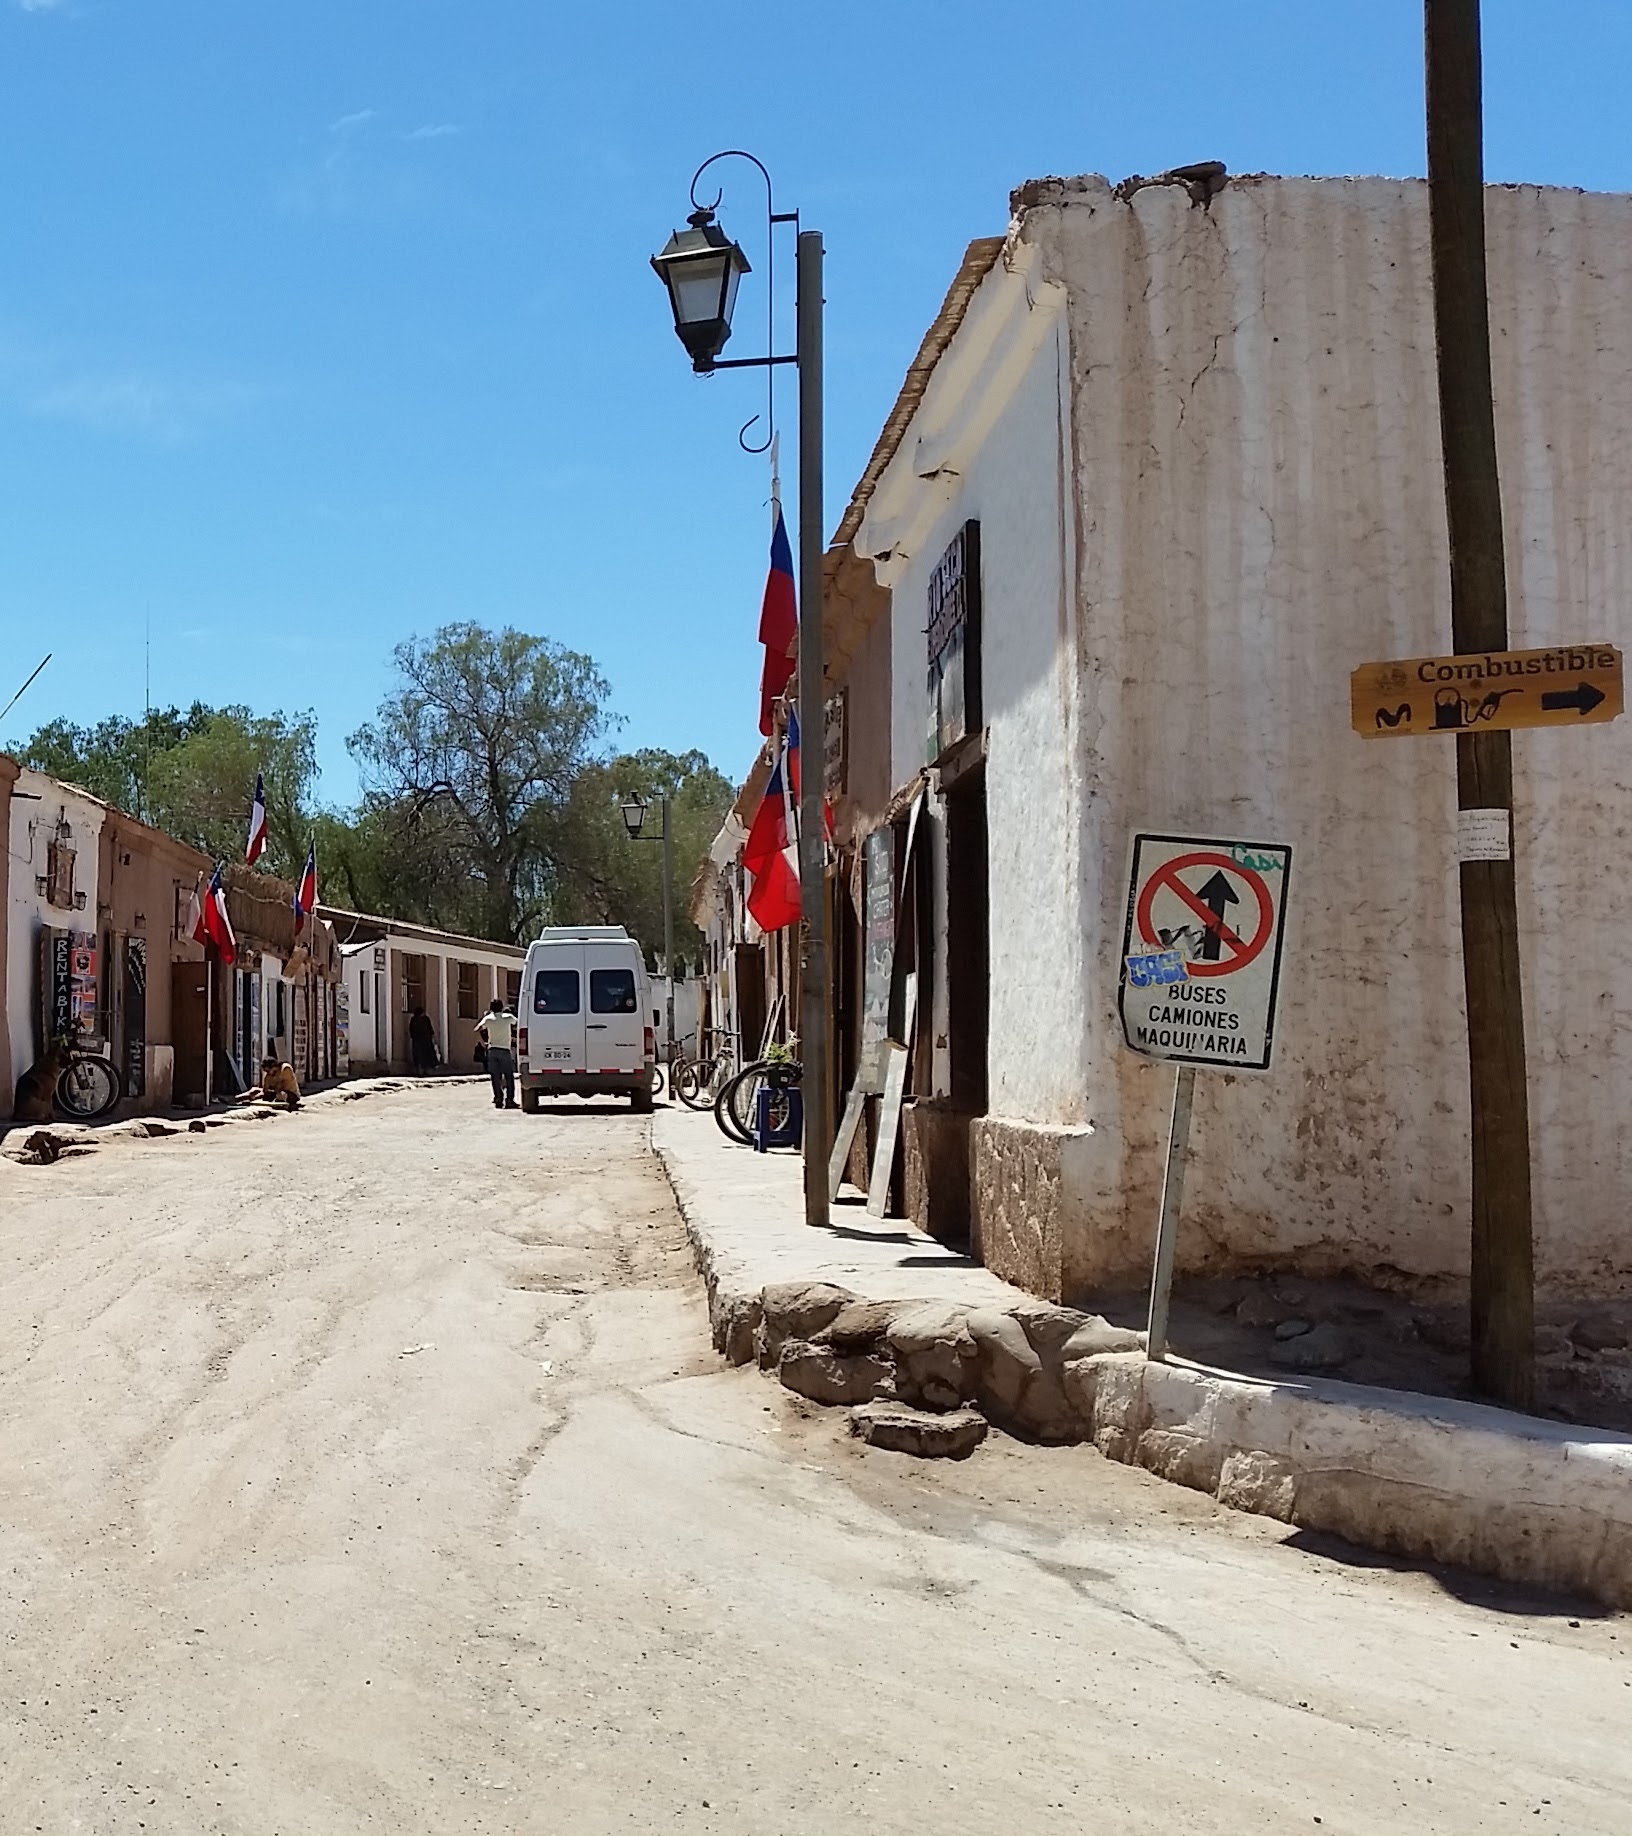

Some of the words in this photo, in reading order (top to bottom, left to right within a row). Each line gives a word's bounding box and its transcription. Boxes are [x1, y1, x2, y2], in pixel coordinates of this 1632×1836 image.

[1417, 648, 1615, 683] Combustible
[56, 939, 68, 983] RENT
[1168, 984, 1227, 1005] BUSES
[56, 995, 68, 1031] BIK
[1148, 1005, 1240, 1030] CAMIONES
